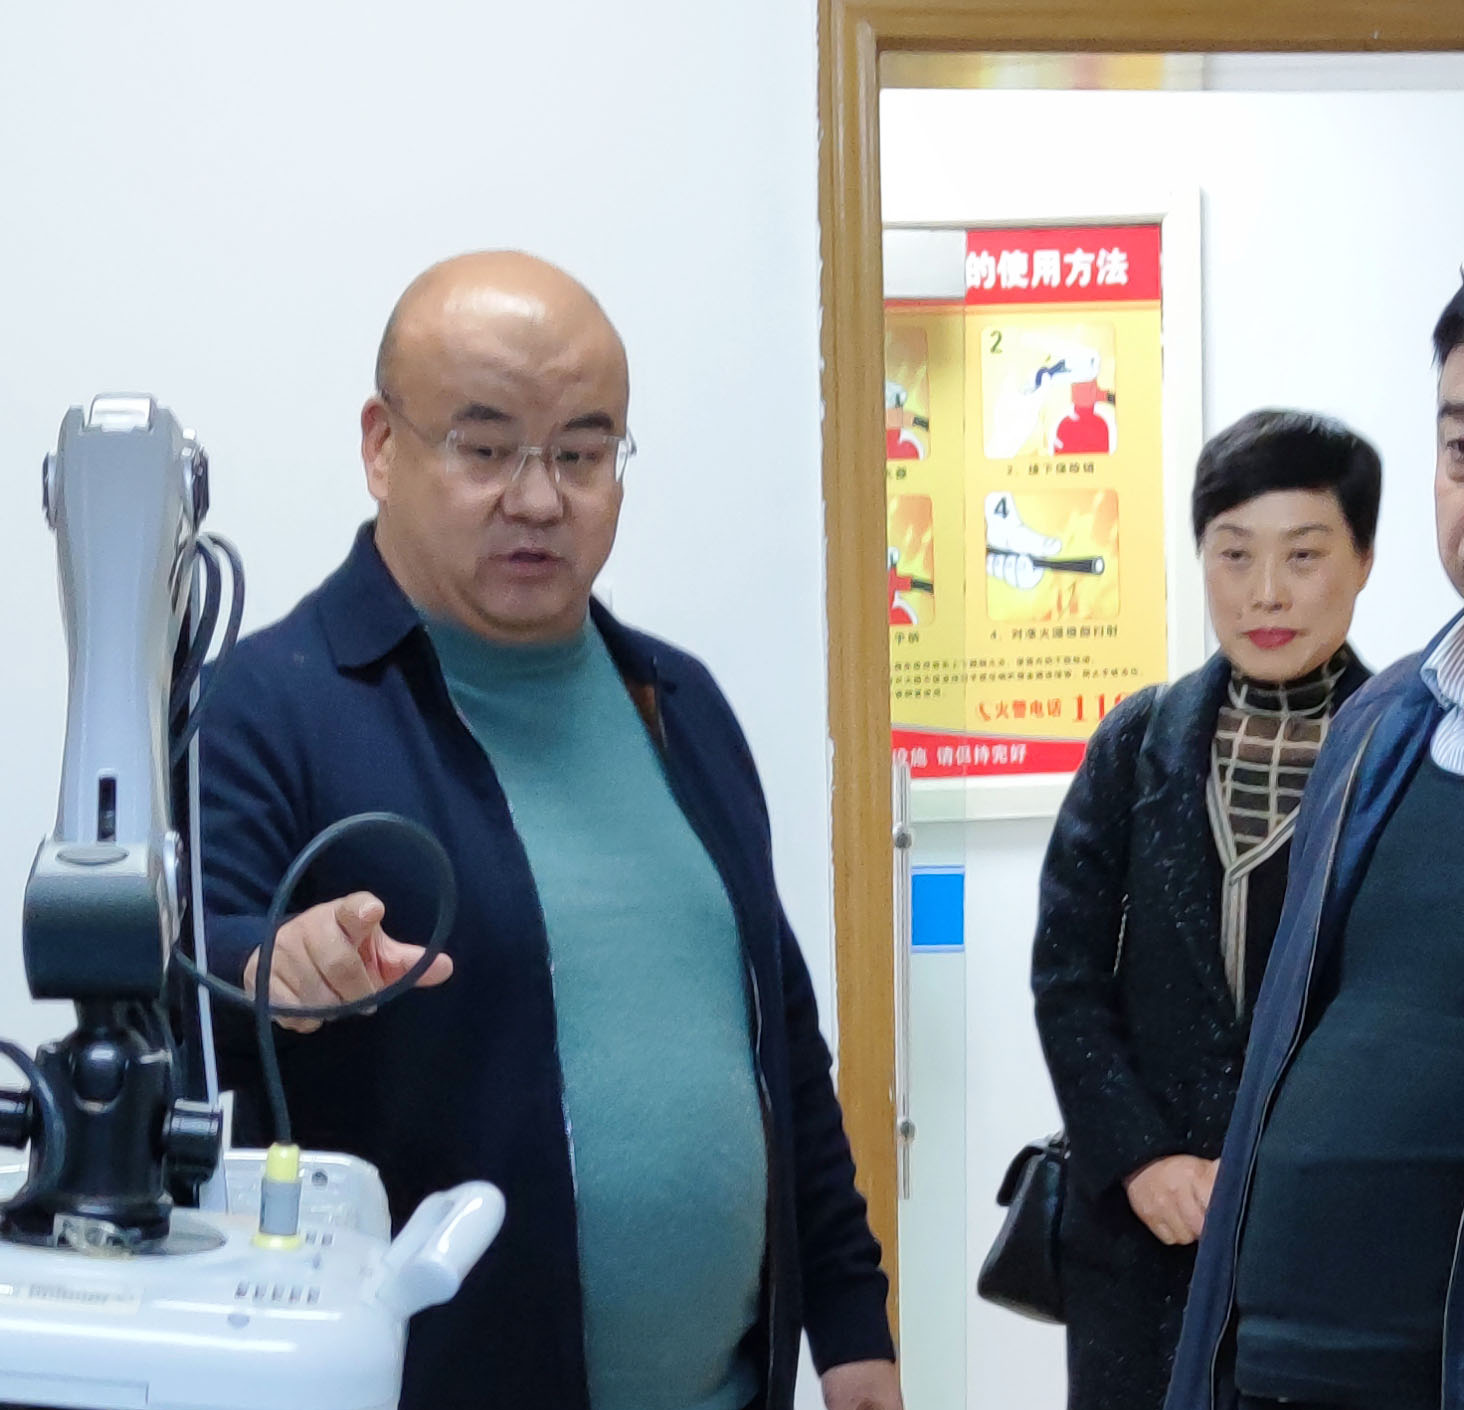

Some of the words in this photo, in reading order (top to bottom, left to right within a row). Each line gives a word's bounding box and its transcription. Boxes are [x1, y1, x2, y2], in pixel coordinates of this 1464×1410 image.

[966, 247, 1129, 289] 的使用方法
[990, 330, 1003, 353] 2
[993, 497, 1009, 519] 4
[995, 698, 1062, 720] 火警电话
